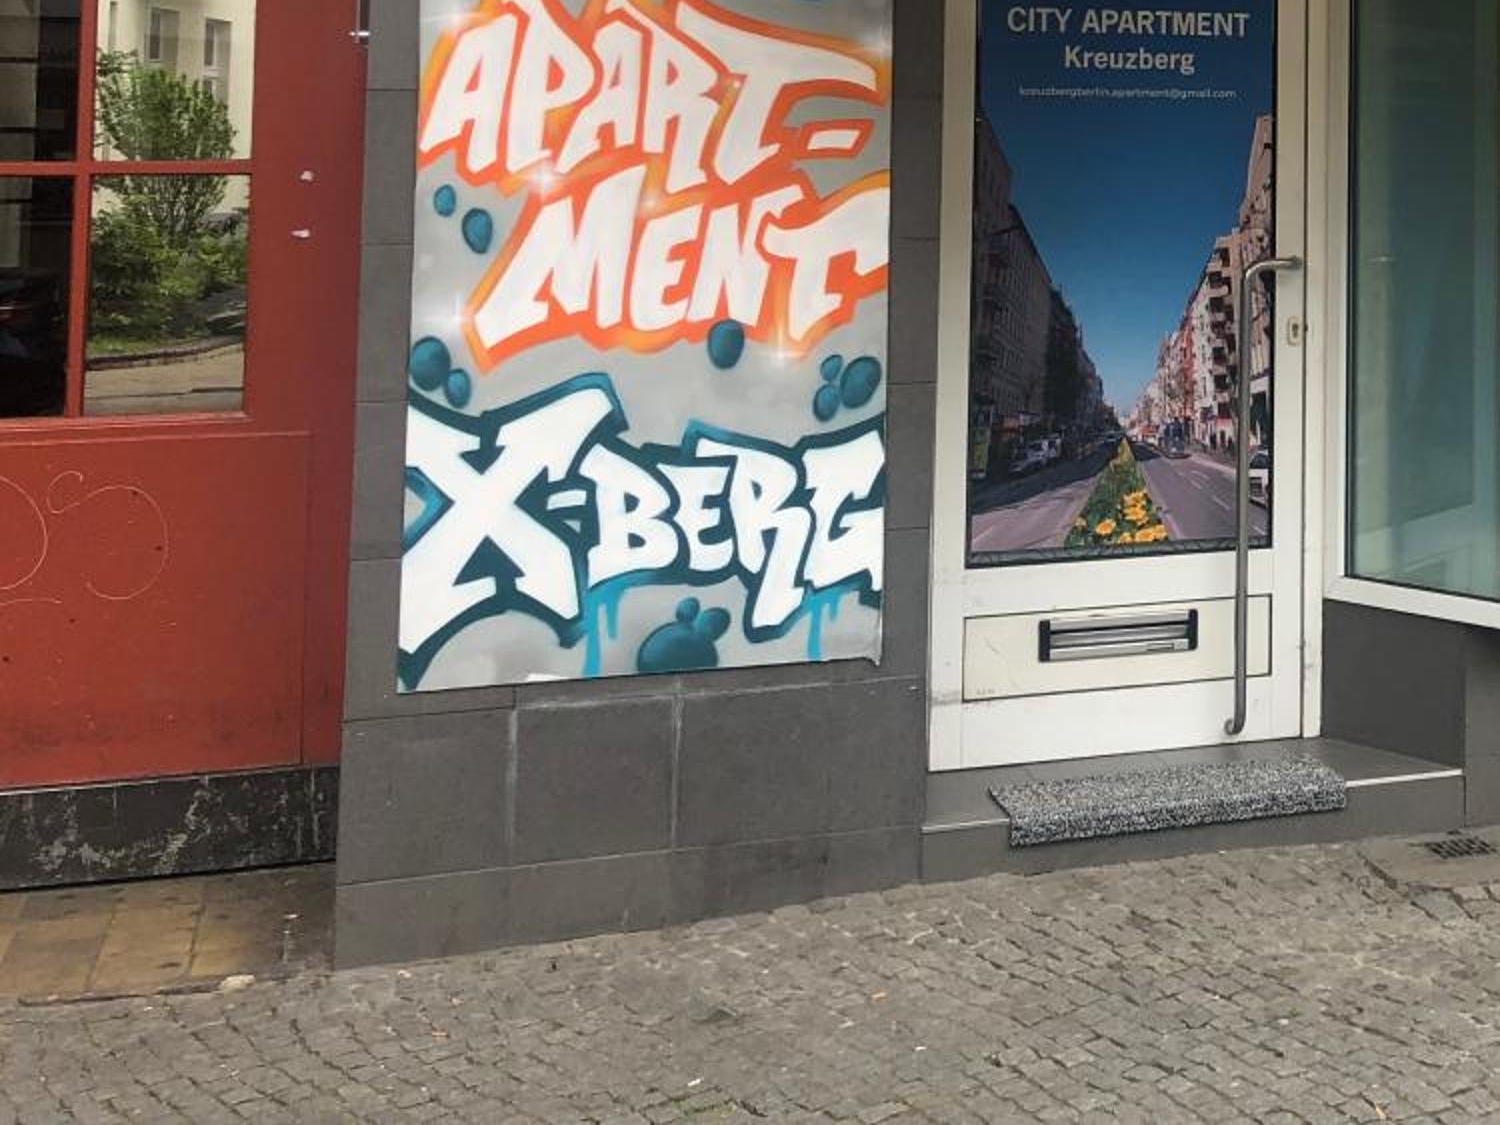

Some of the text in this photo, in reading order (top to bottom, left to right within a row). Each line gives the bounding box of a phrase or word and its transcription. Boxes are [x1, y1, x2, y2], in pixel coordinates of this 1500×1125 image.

[1007, 6, 1250, 37] CITY APARTMENT
[1064, 44, 1196, 75] Kreuzberg
[468, 165, 889, 357] MENT
[400, 380, 885, 665] X-BERG
